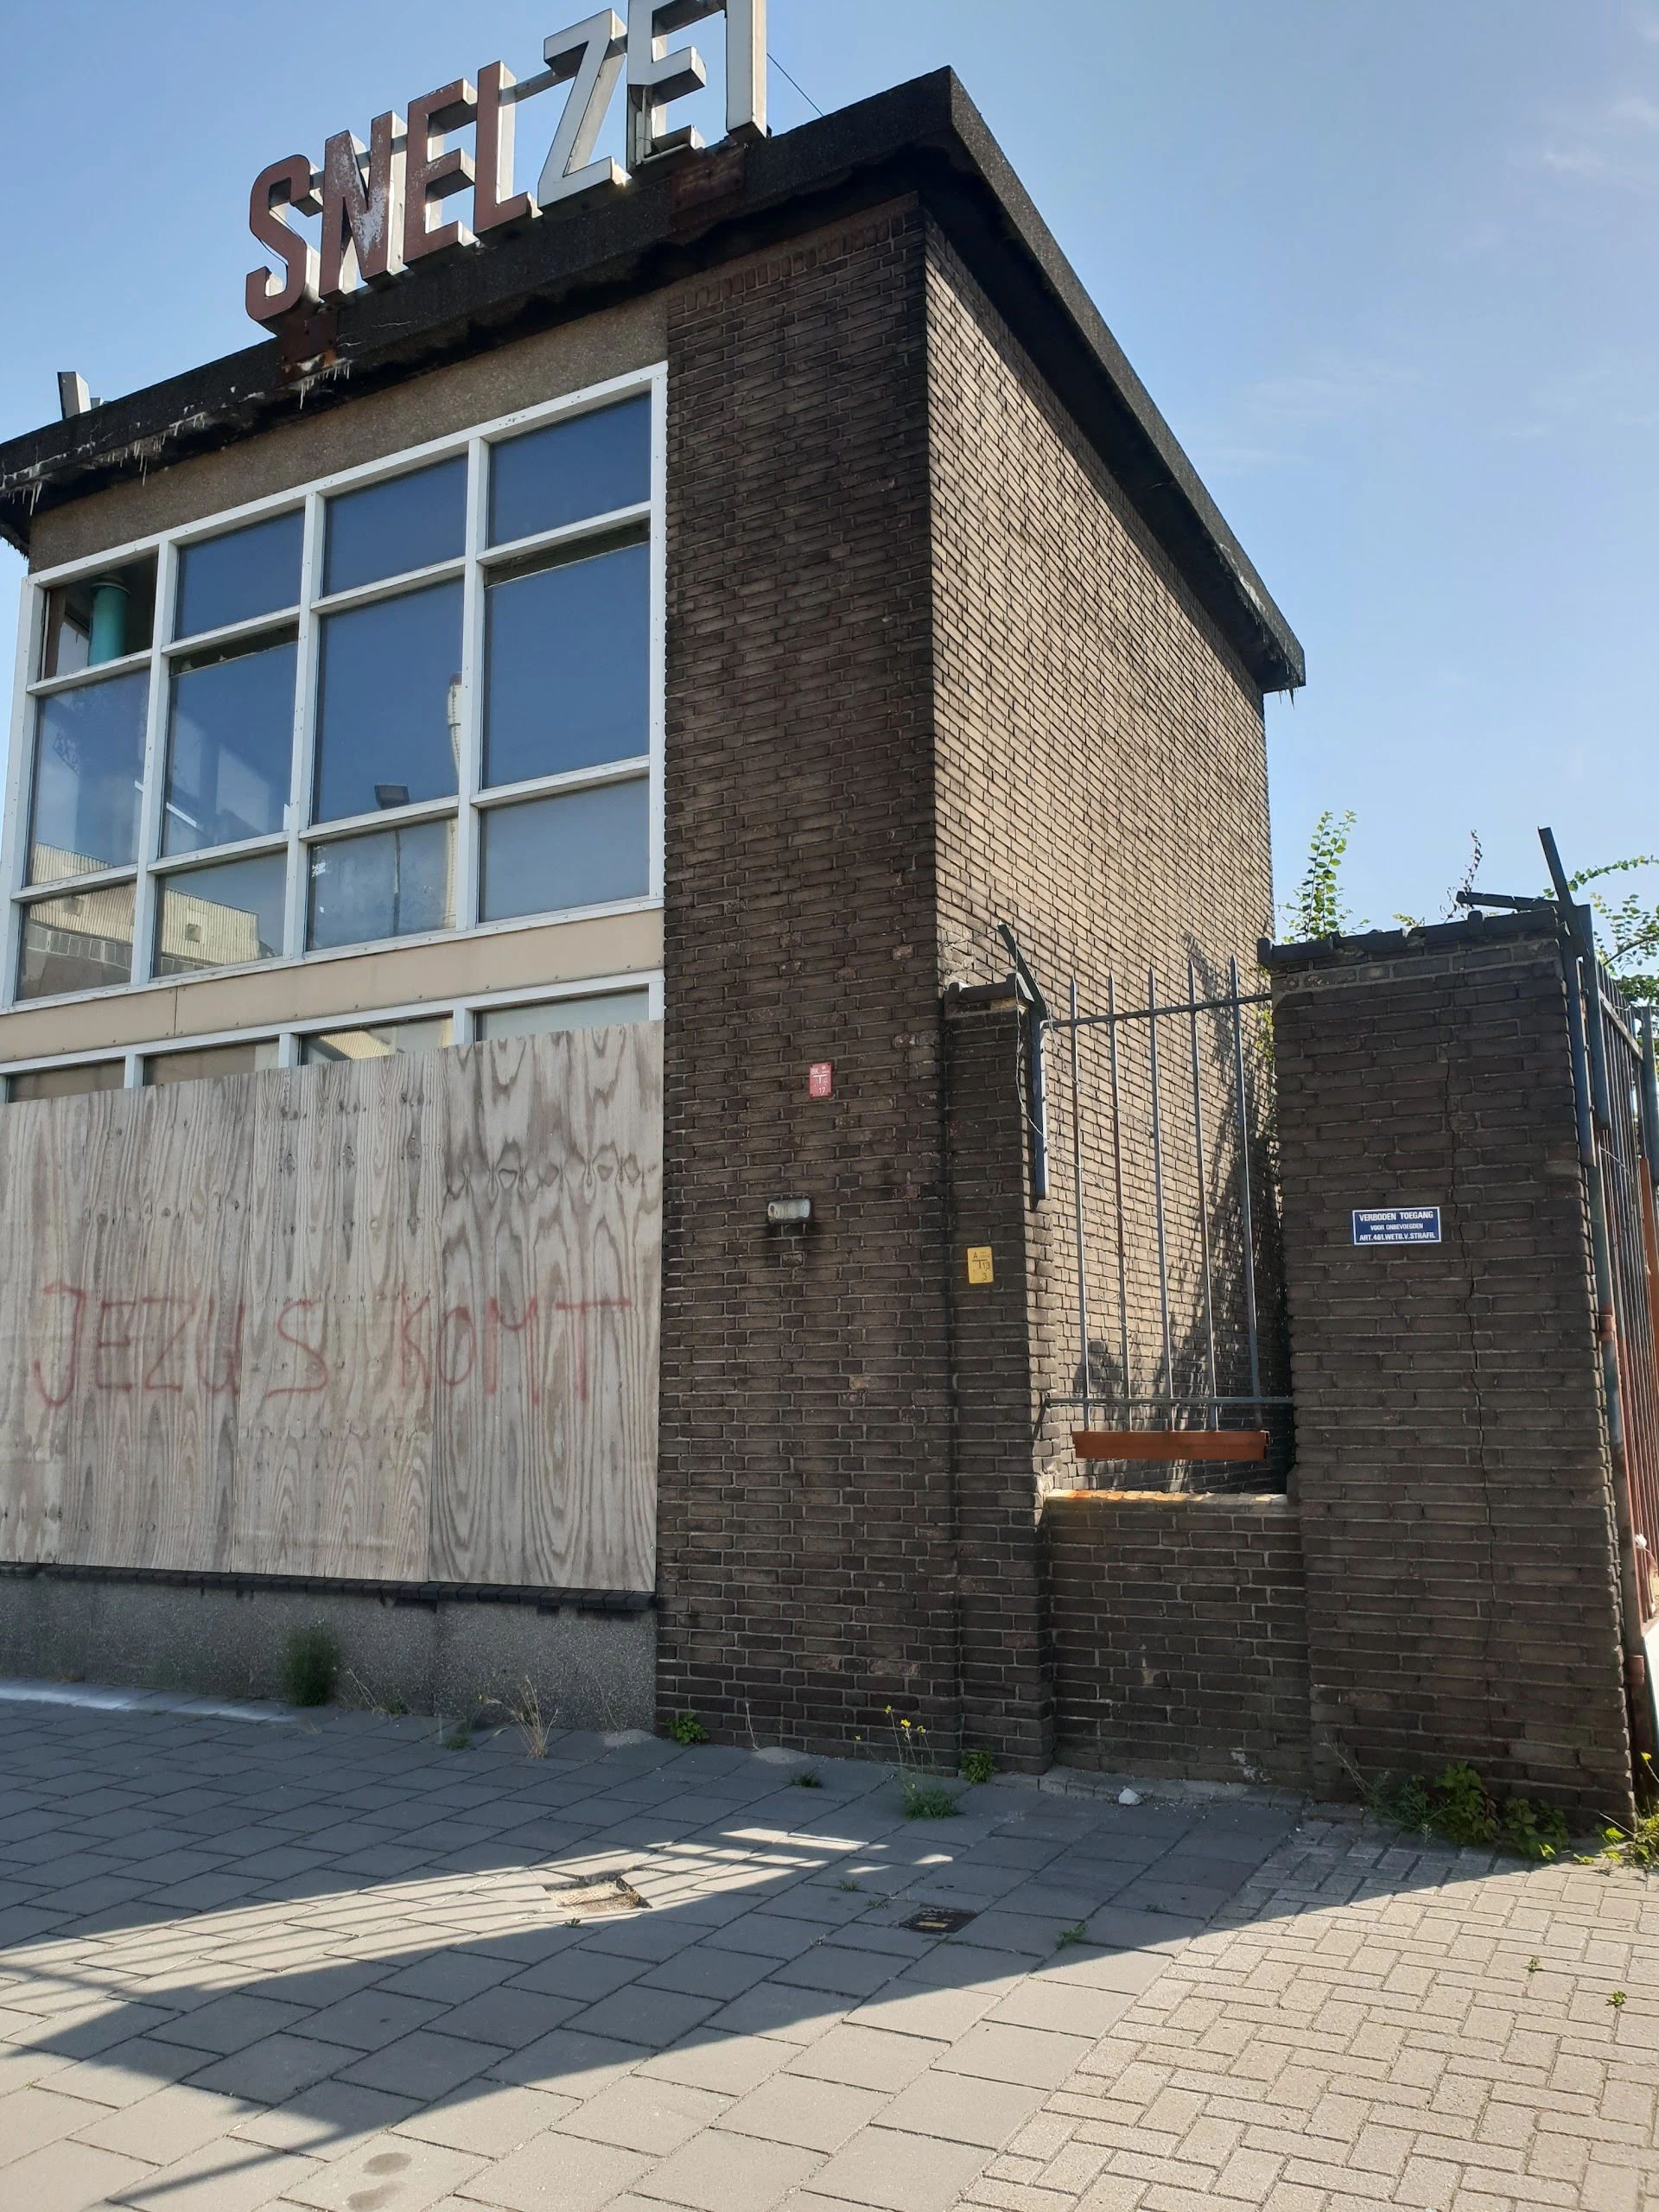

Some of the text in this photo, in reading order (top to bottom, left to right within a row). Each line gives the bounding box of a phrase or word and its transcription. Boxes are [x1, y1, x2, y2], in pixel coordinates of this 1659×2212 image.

[1359, 1211, 1433, 1221] VERBODEN TOEGANG
[34, 1281, 632, 1407] JEZUS KOMT
